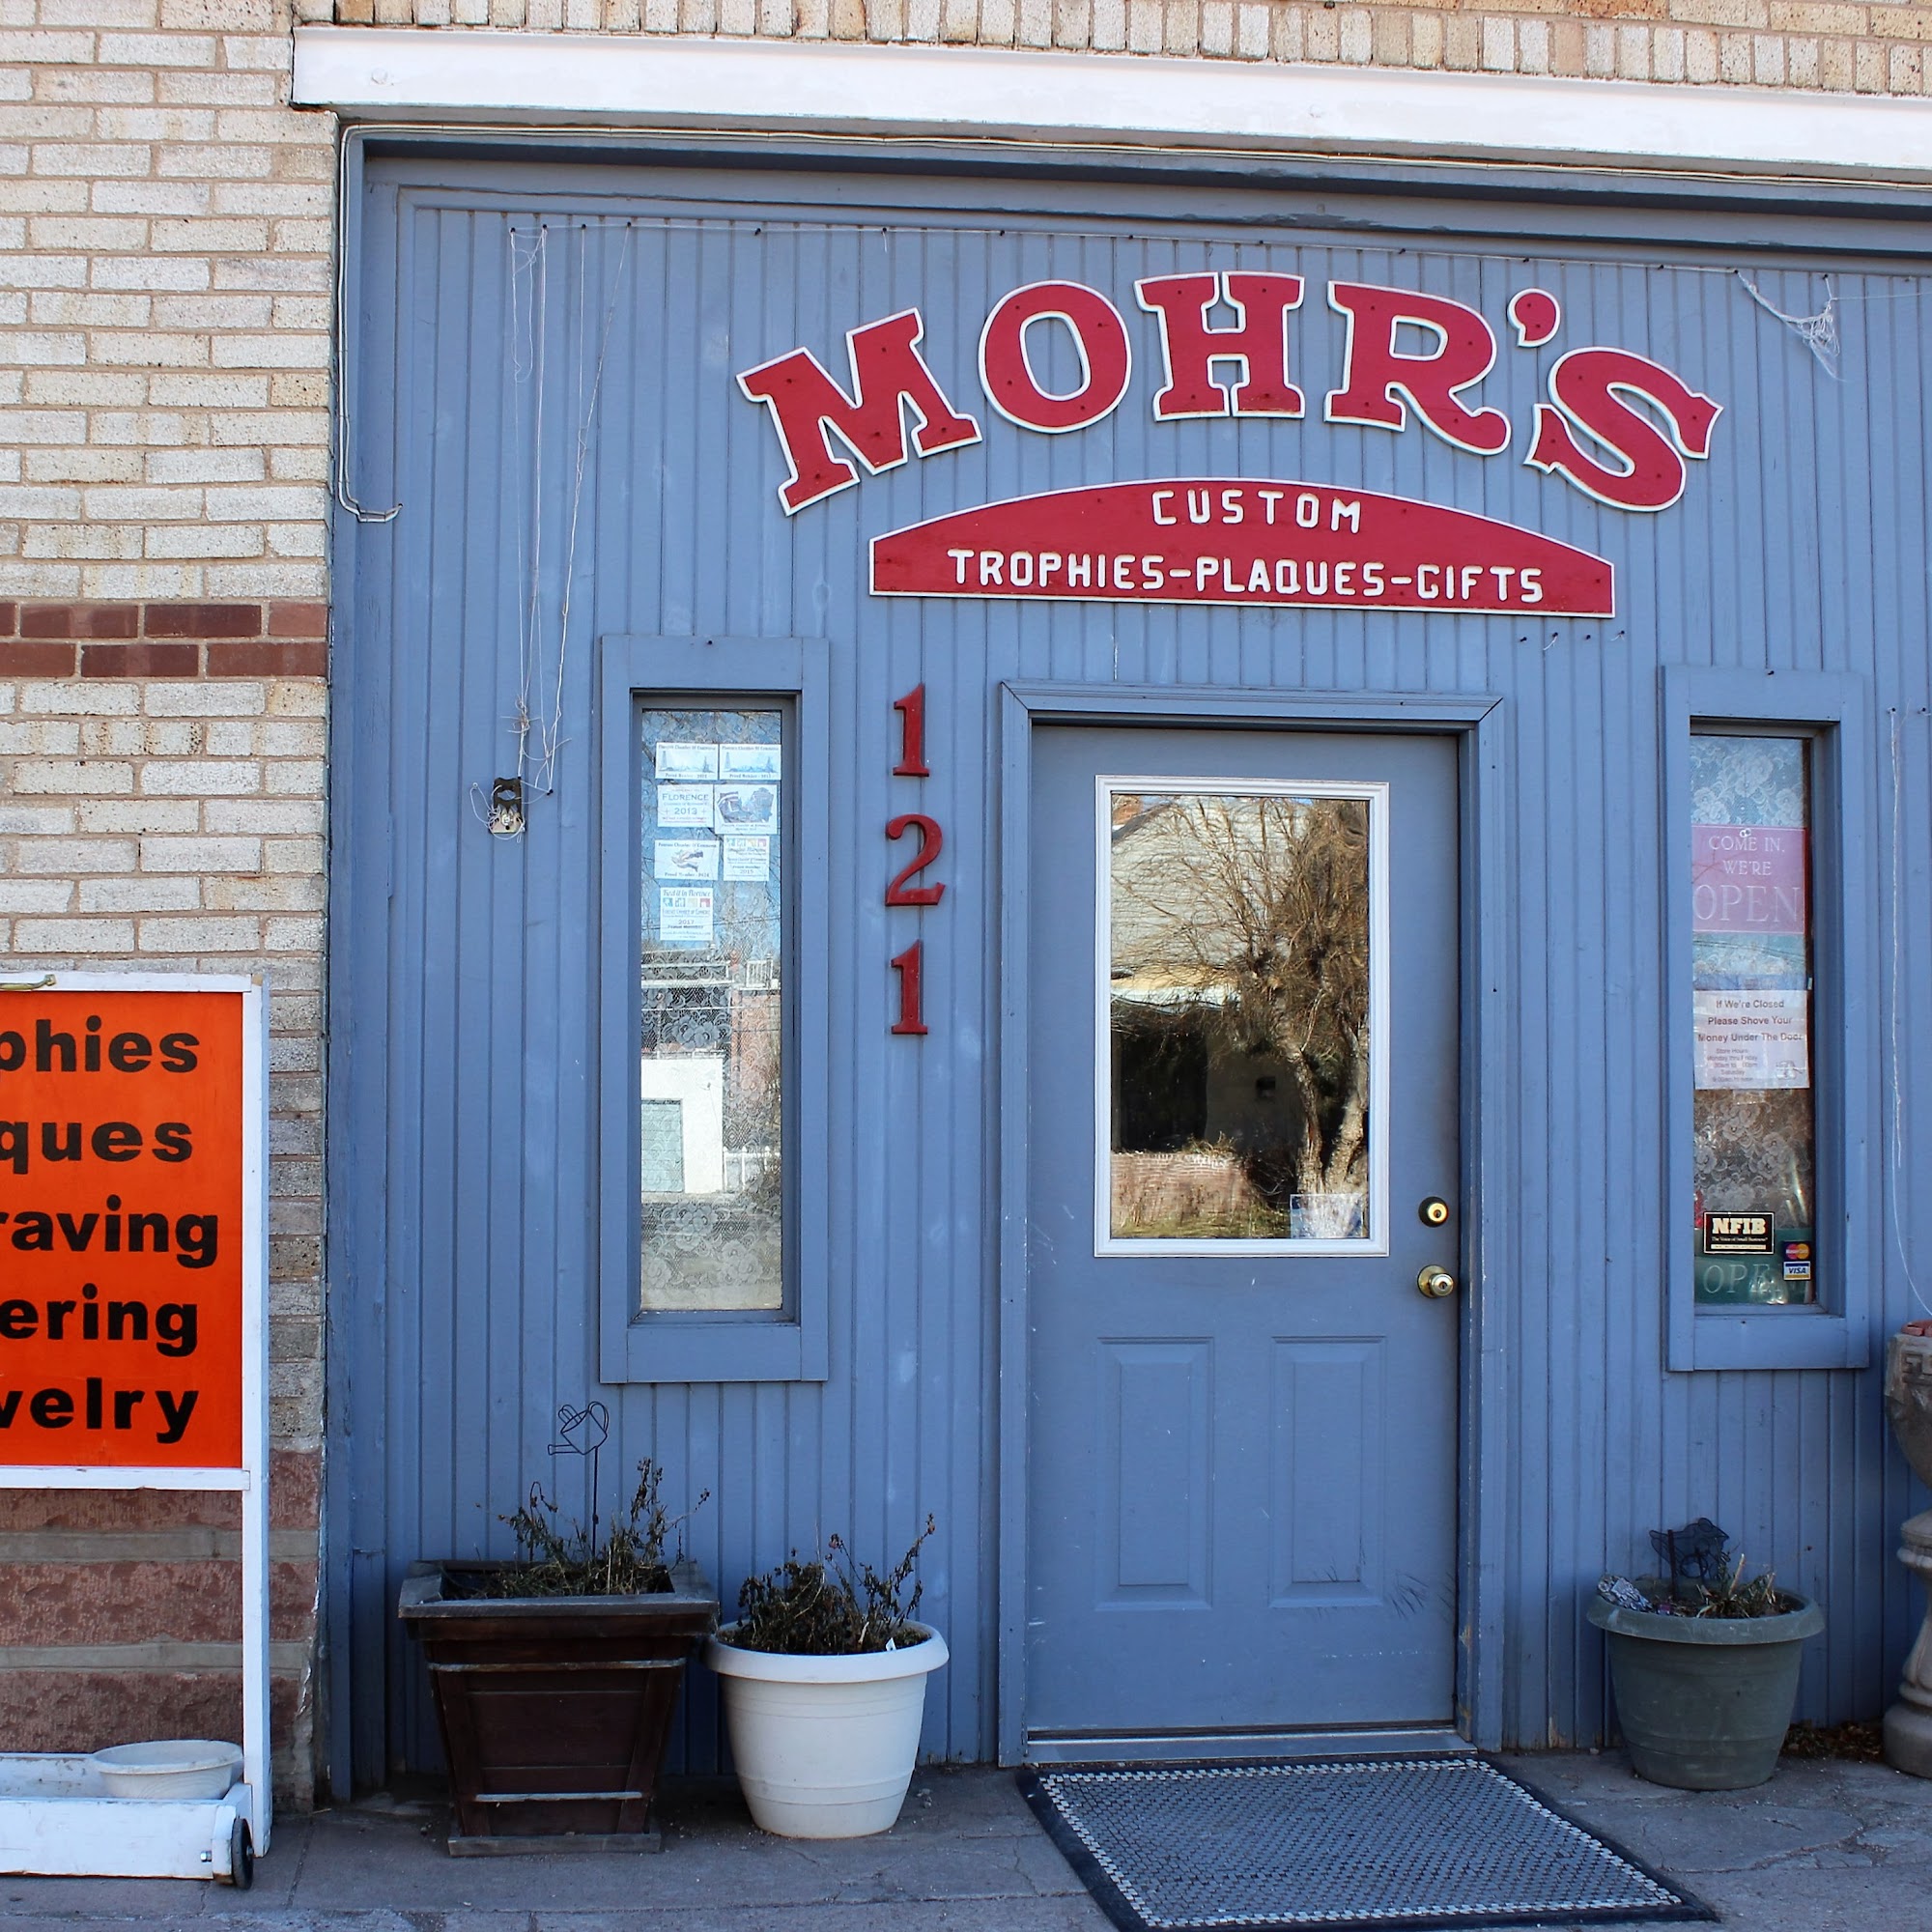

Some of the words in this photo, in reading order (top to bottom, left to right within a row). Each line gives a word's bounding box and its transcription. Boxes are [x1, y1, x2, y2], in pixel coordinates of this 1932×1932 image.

[737, 271, 1722, 515] MOHR'S
[1152, 489, 1361, 534] CUSTOM
[947, 549, 1543, 603] TROPHIES-PLAQUES-GIFTS
[674, 807, 697, 815] 2013
[1708, 836, 1758, 851] COME
[1722, 860, 1773, 876] WE'RE
[1692, 884, 1802, 923] OPEN
[1716, 1000, 1723, 1009] If
[1724, 1000, 1750, 1009] We're
[1752, 1000, 1785, 1009] Closed
[1708, 1016, 1738, 1025] Please
[1741, 1016, 1770, 1025] Shove
[1772, 1015, 1793, 1024] Your
[1698, 1034, 1728, 1043] Money
[1761, 1033, 1778, 1041] The
[0, 1122, 192, 1176] ques
[0, 1195, 218, 1268] aving
[1712, 1217, 1766, 1235] NFIB
[1703, 1264, 1784, 1294] OPE
[0, 1283, 199, 1357] ering
